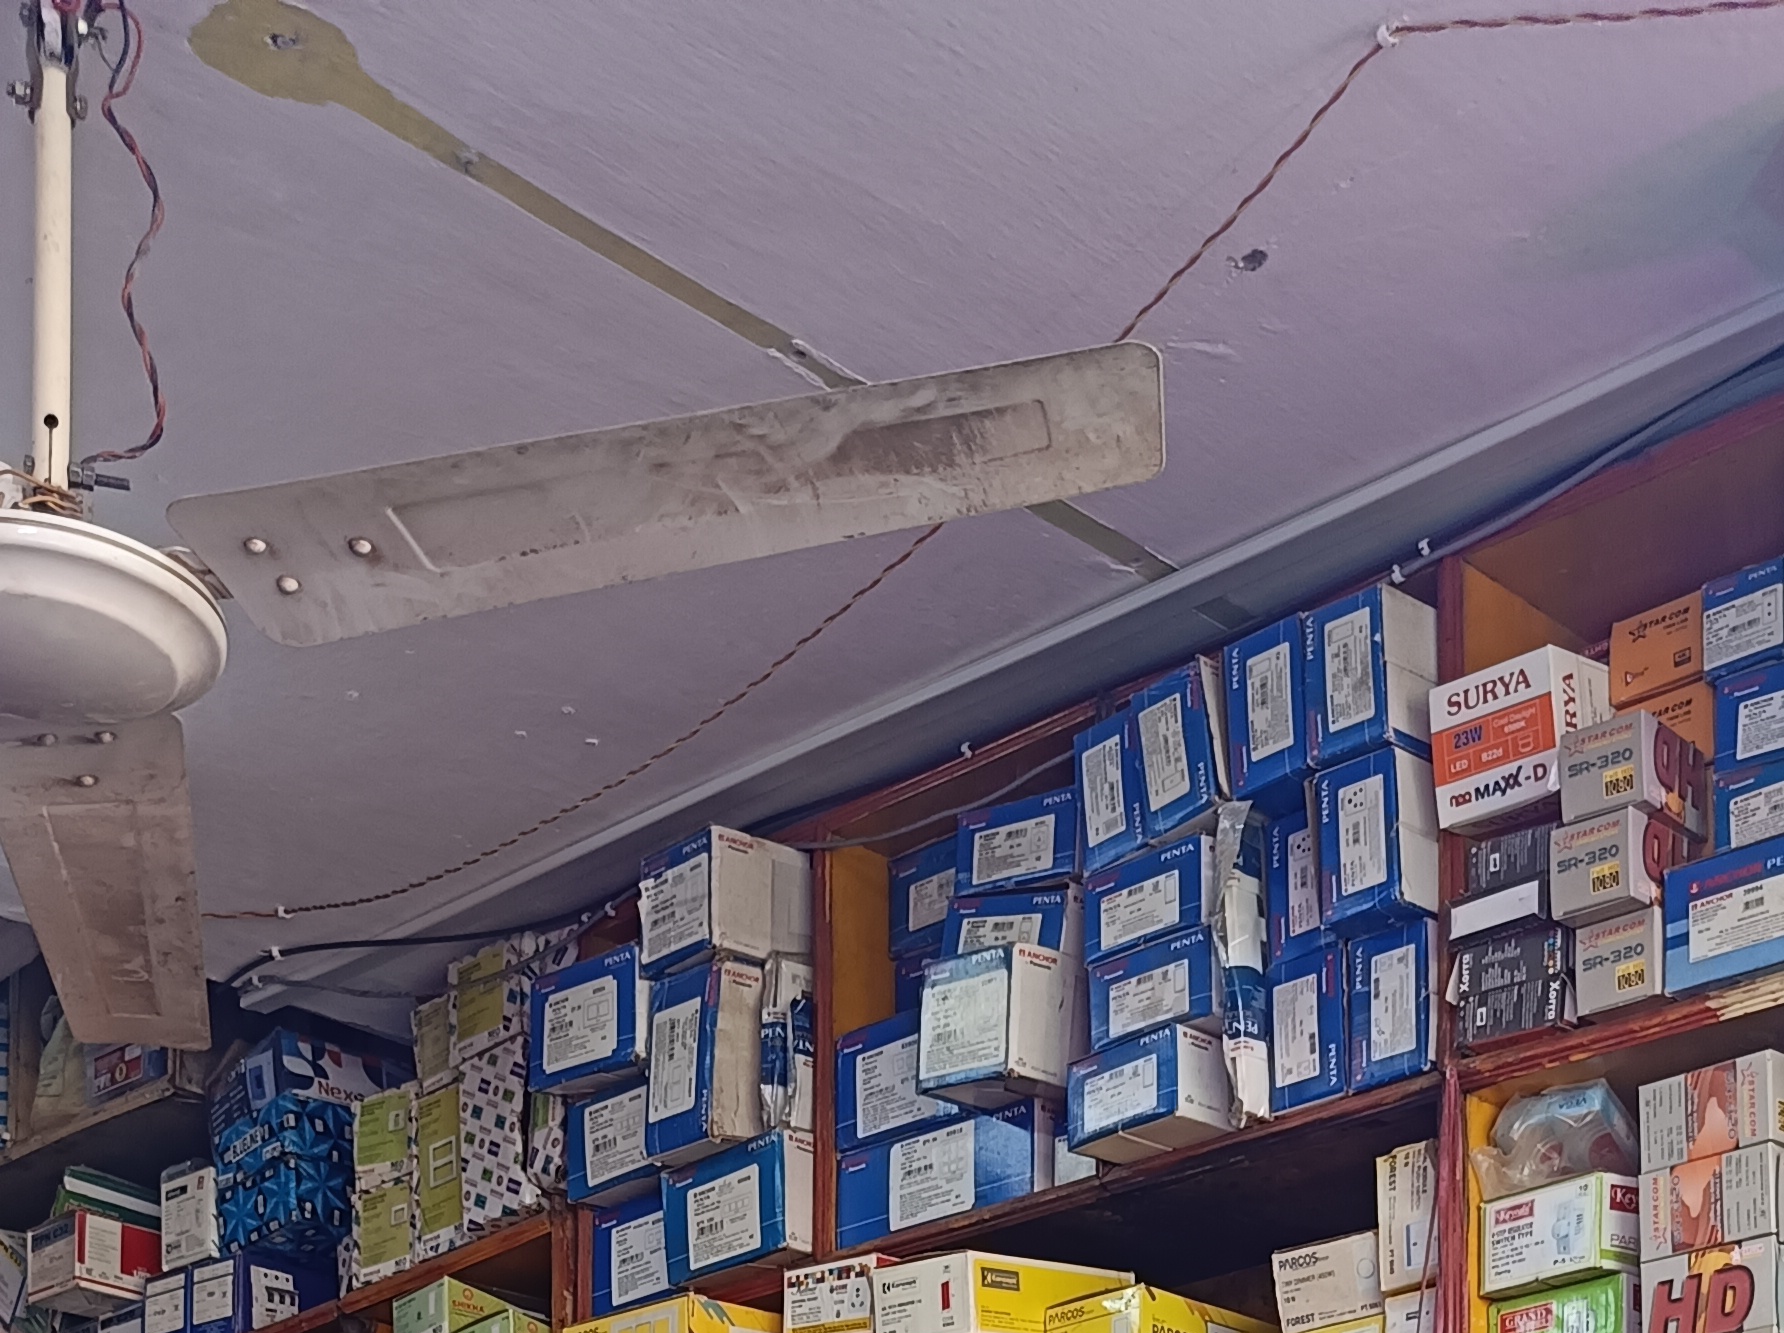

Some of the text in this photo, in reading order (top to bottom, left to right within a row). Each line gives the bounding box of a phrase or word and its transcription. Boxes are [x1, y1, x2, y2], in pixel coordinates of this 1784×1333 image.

[1306, 616, 1314, 660] PENTA
[1232, 647, 1240, 690] PENTA
[1446, 668, 1532, 717] SURYA
[1453, 724, 1483, 750] 23W
[1451, 759, 1468, 773] LED
[1567, 748, 1634, 778] SR-320
[1321, 779, 1329, 823] PENTA
[1160, 843, 1195, 862] PENTA
[1557, 844, 1620, 874] SR-320
[1171, 932, 1204, 951] PENTA
[1027, 949, 1058, 965] ANCHOR
[1355, 946, 1363, 990] PENTA
[1582, 943, 1645, 973] SR-320
[1139, 1028, 1172, 1047] PENTA
[1329, 1043, 1337, 1086] PENTA
[1277, 1252, 1319, 1271] PARCOS
[452, 1299, 485, 1314] SHIKHA
[1048, 1306, 1085, 1325] PARCOS
[1505, 1308, 1547, 1328] GRAND
[1286, 1312, 1315, 1327] FOREST
